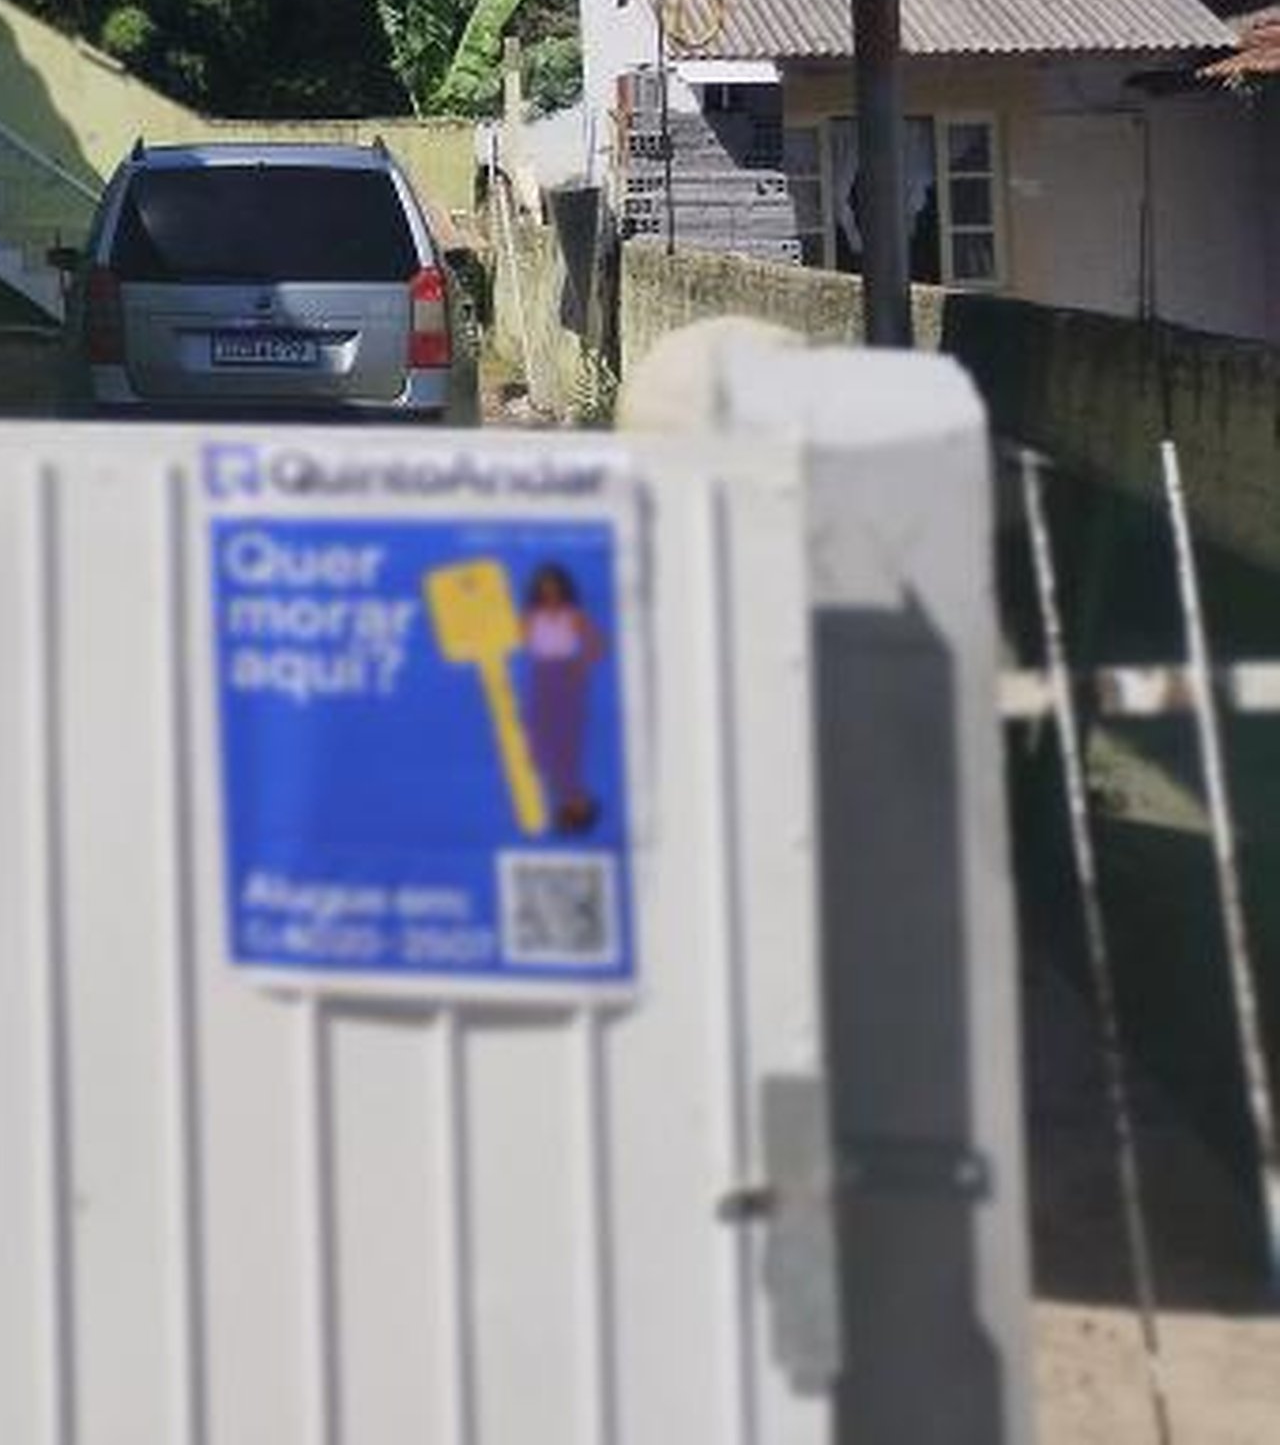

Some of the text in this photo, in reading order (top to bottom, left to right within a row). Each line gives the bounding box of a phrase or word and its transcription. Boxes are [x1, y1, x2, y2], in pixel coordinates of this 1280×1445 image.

[226, 532, 384, 588] Quer
[229, 599, 415, 640] morar
[234, 640, 405, 706] aqui?
